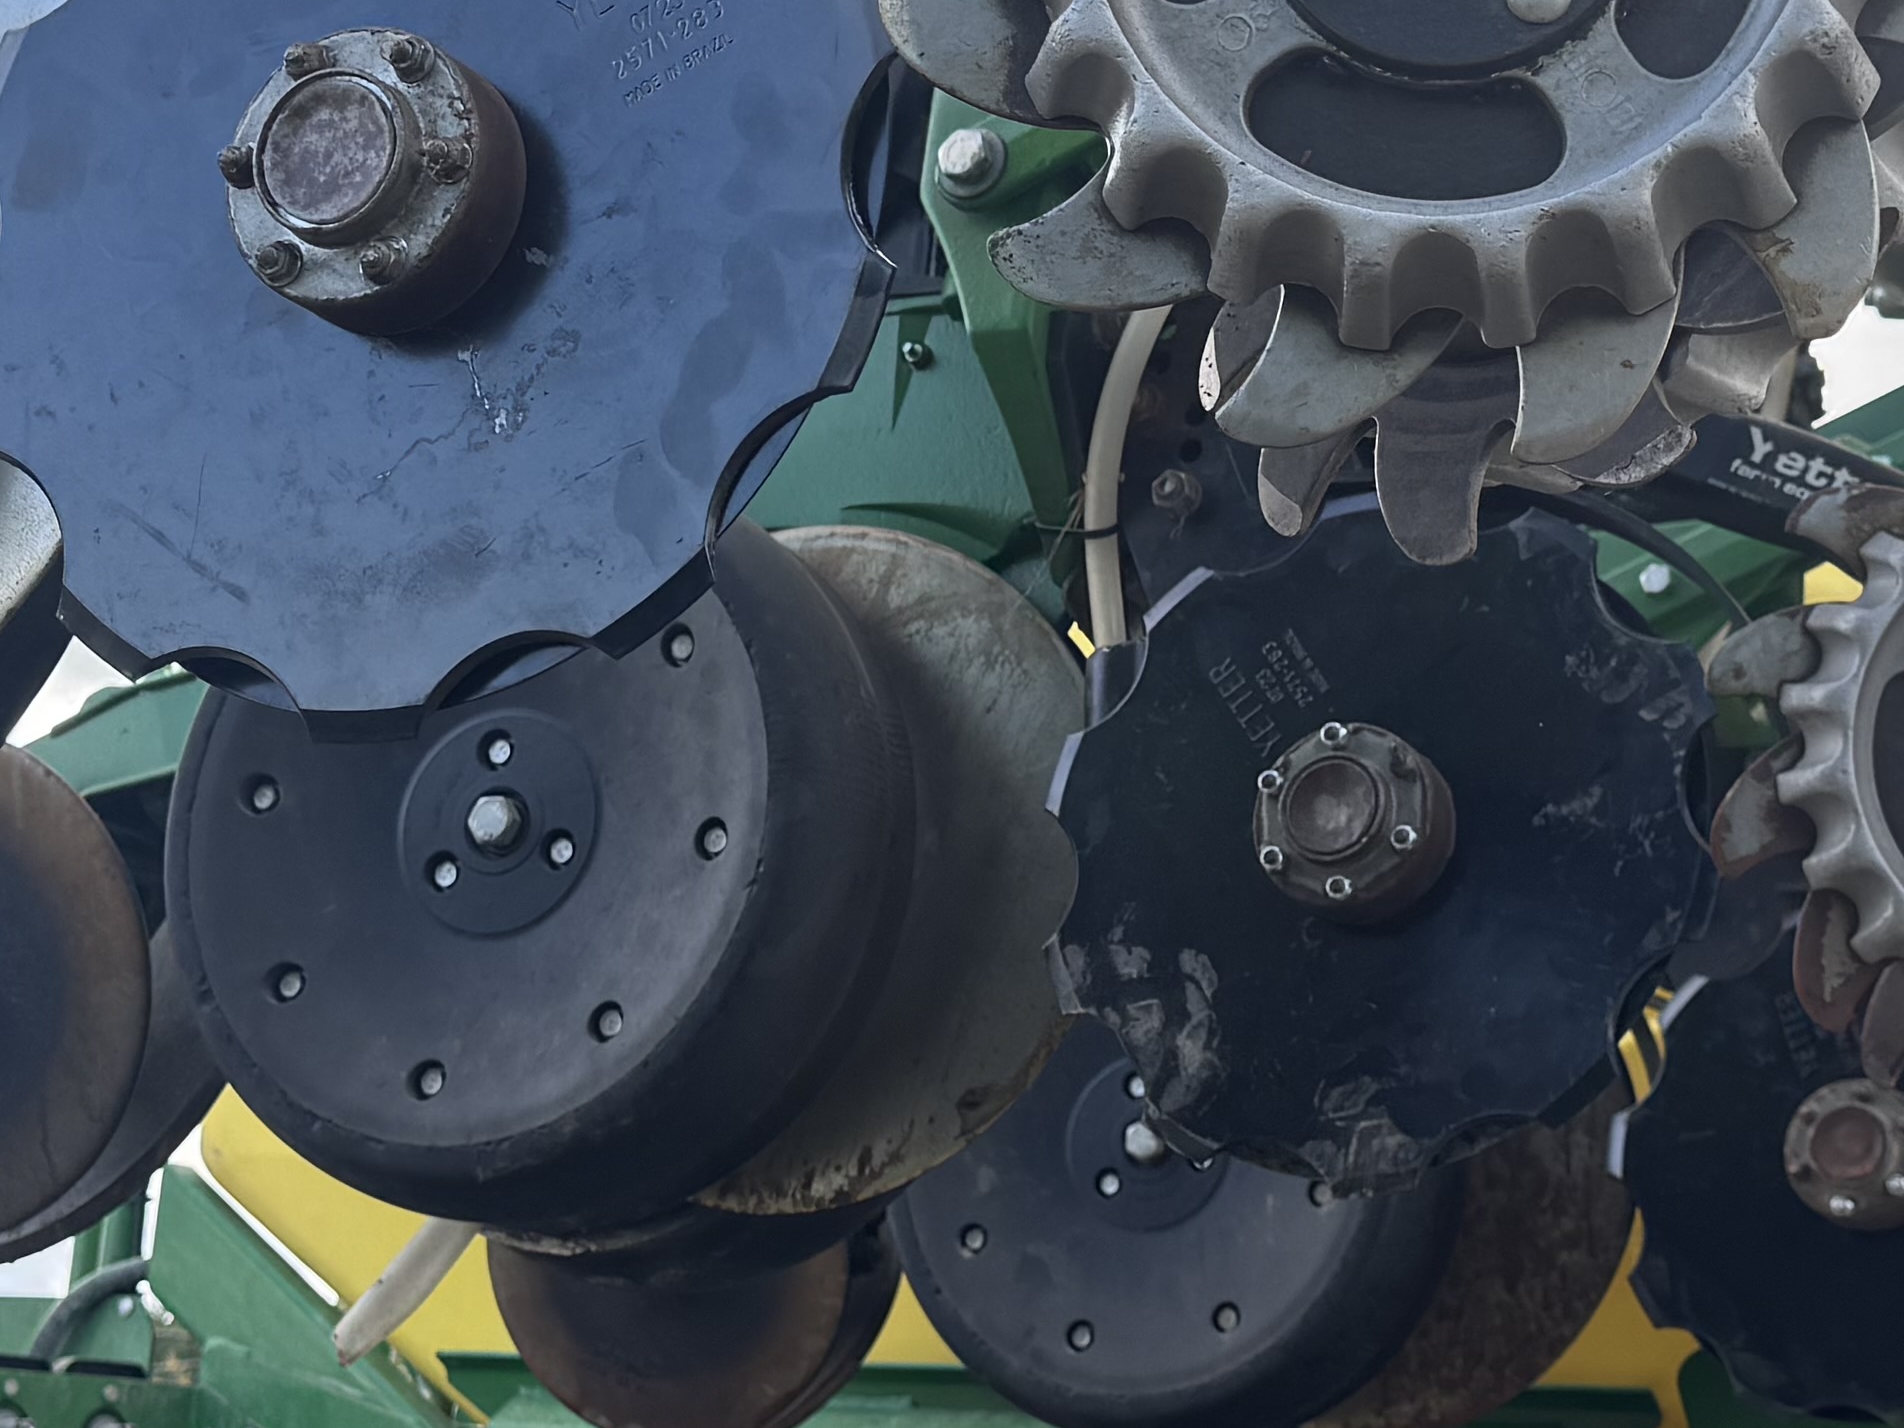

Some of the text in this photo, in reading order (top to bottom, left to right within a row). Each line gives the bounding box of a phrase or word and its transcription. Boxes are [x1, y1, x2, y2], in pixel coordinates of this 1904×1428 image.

[623, 33, 734, 108] MADE IN BRAZIL
[1205, 655, 1283, 757] YETTER
